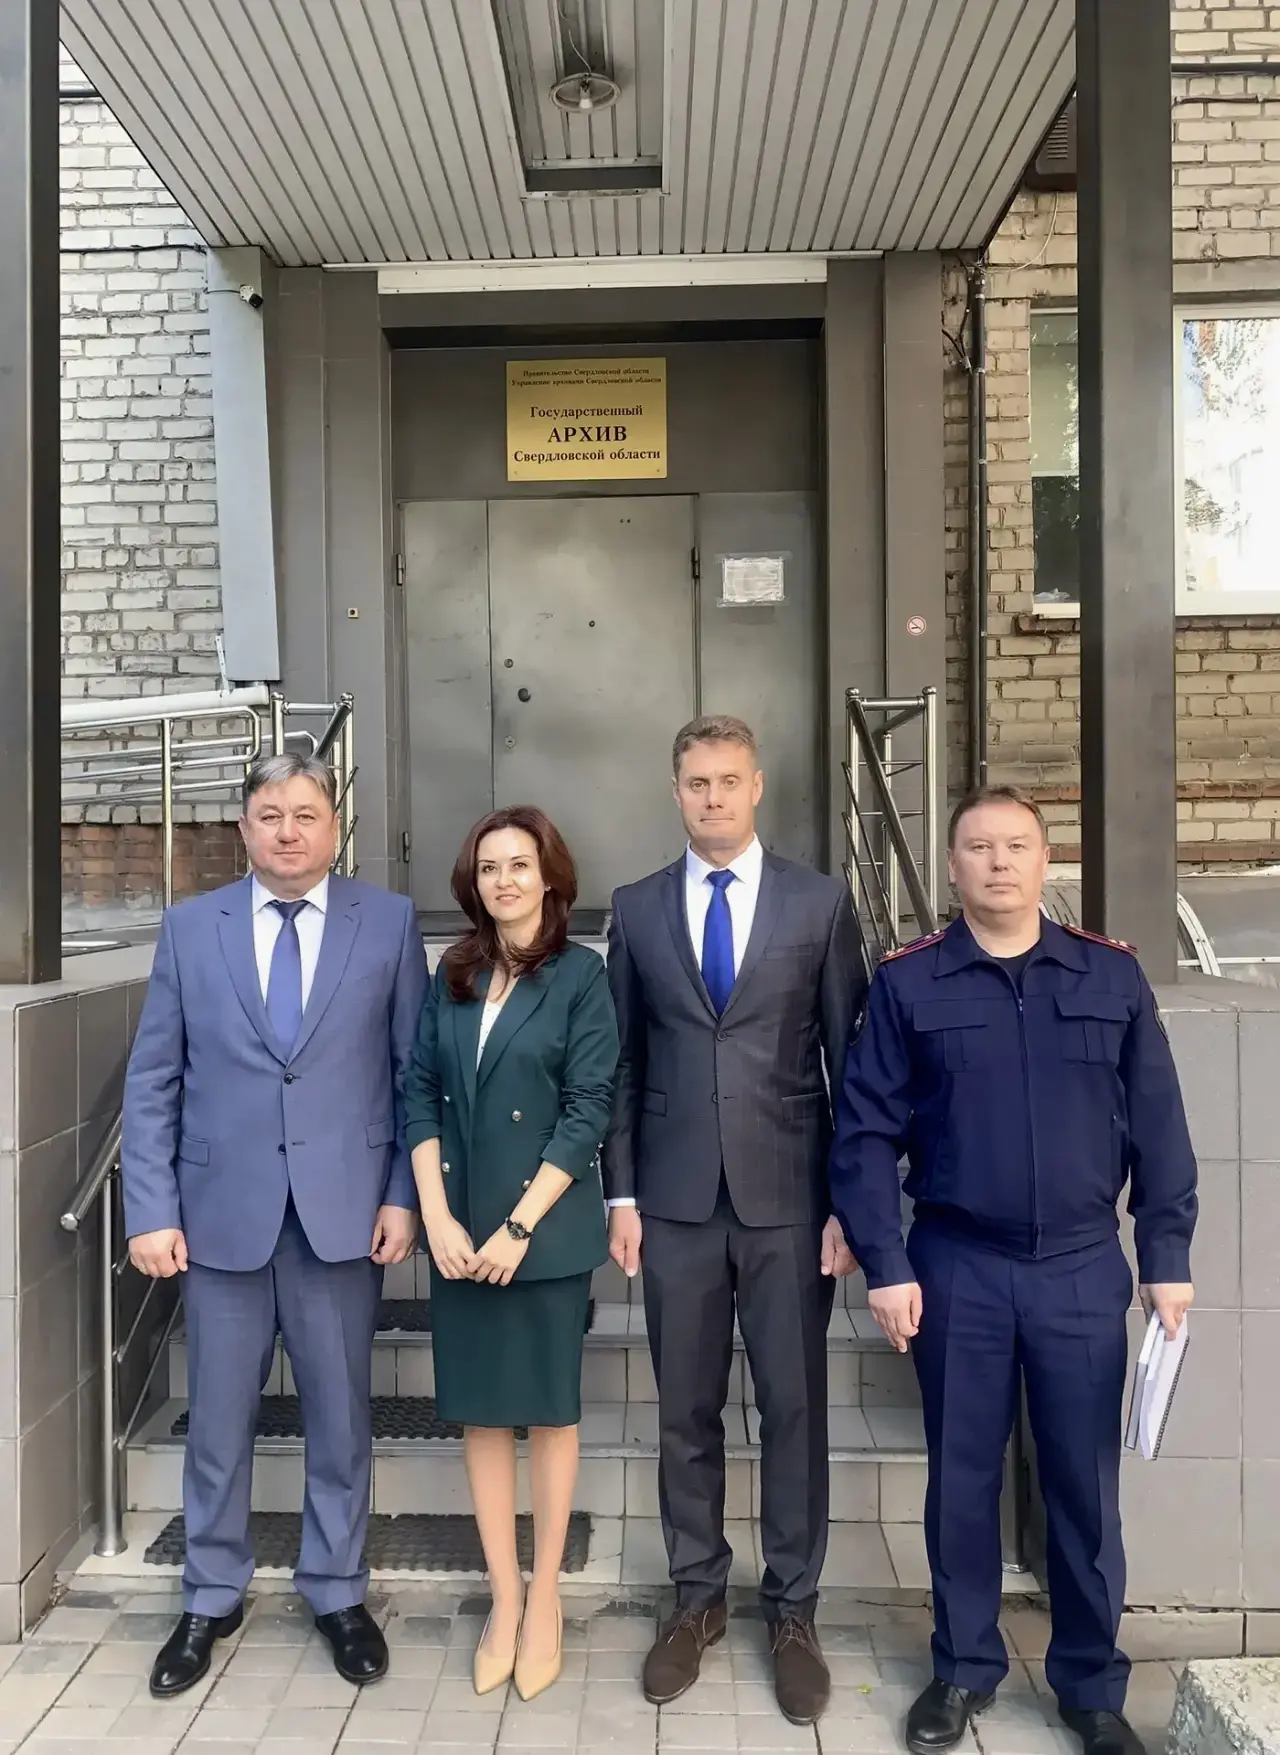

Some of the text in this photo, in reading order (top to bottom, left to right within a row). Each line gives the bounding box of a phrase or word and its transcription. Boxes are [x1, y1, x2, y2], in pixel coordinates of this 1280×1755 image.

[573, 368, 621, 376] Свердловской
[511, 379, 550, 387] Управление
[586, 377, 633, 385] Свердловской
[530, 405, 643, 420] Государственный
[547, 425, 627, 443] АРХИВ
[514, 448, 661, 464] Свердловской области
